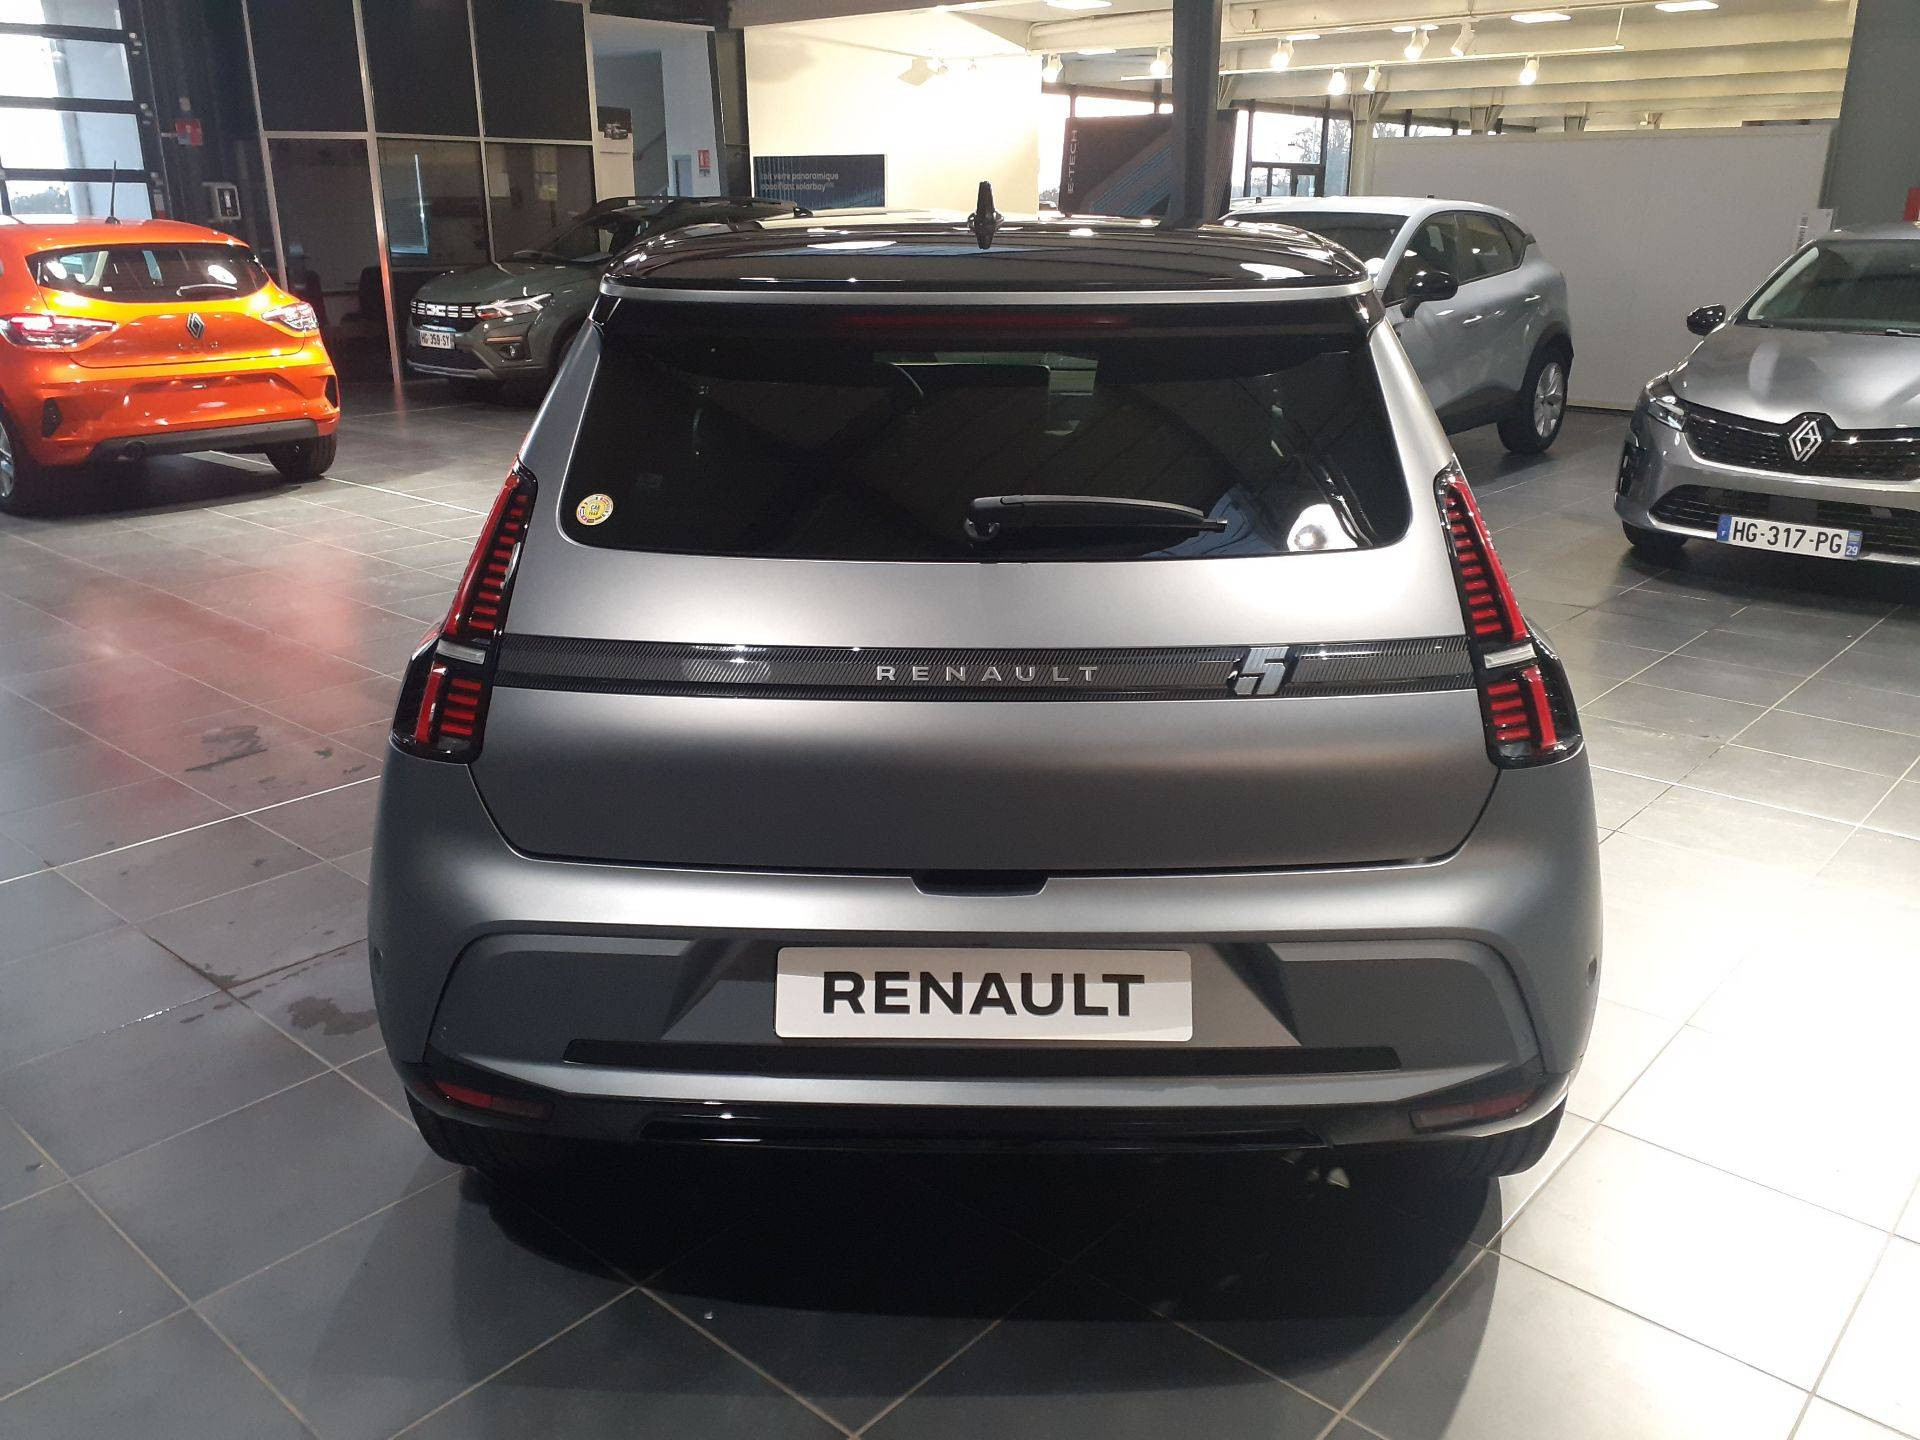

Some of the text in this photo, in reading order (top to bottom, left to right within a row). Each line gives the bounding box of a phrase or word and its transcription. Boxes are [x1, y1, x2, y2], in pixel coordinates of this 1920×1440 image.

[792, 172, 839, 182] panoramique
[1732, 520, 1843, 554] HG-317-PG
[1845, 545, 1858, 556] 29
[876, 665, 1099, 683] RENAULT
[822, 970, 1145, 1017] RENAULT
